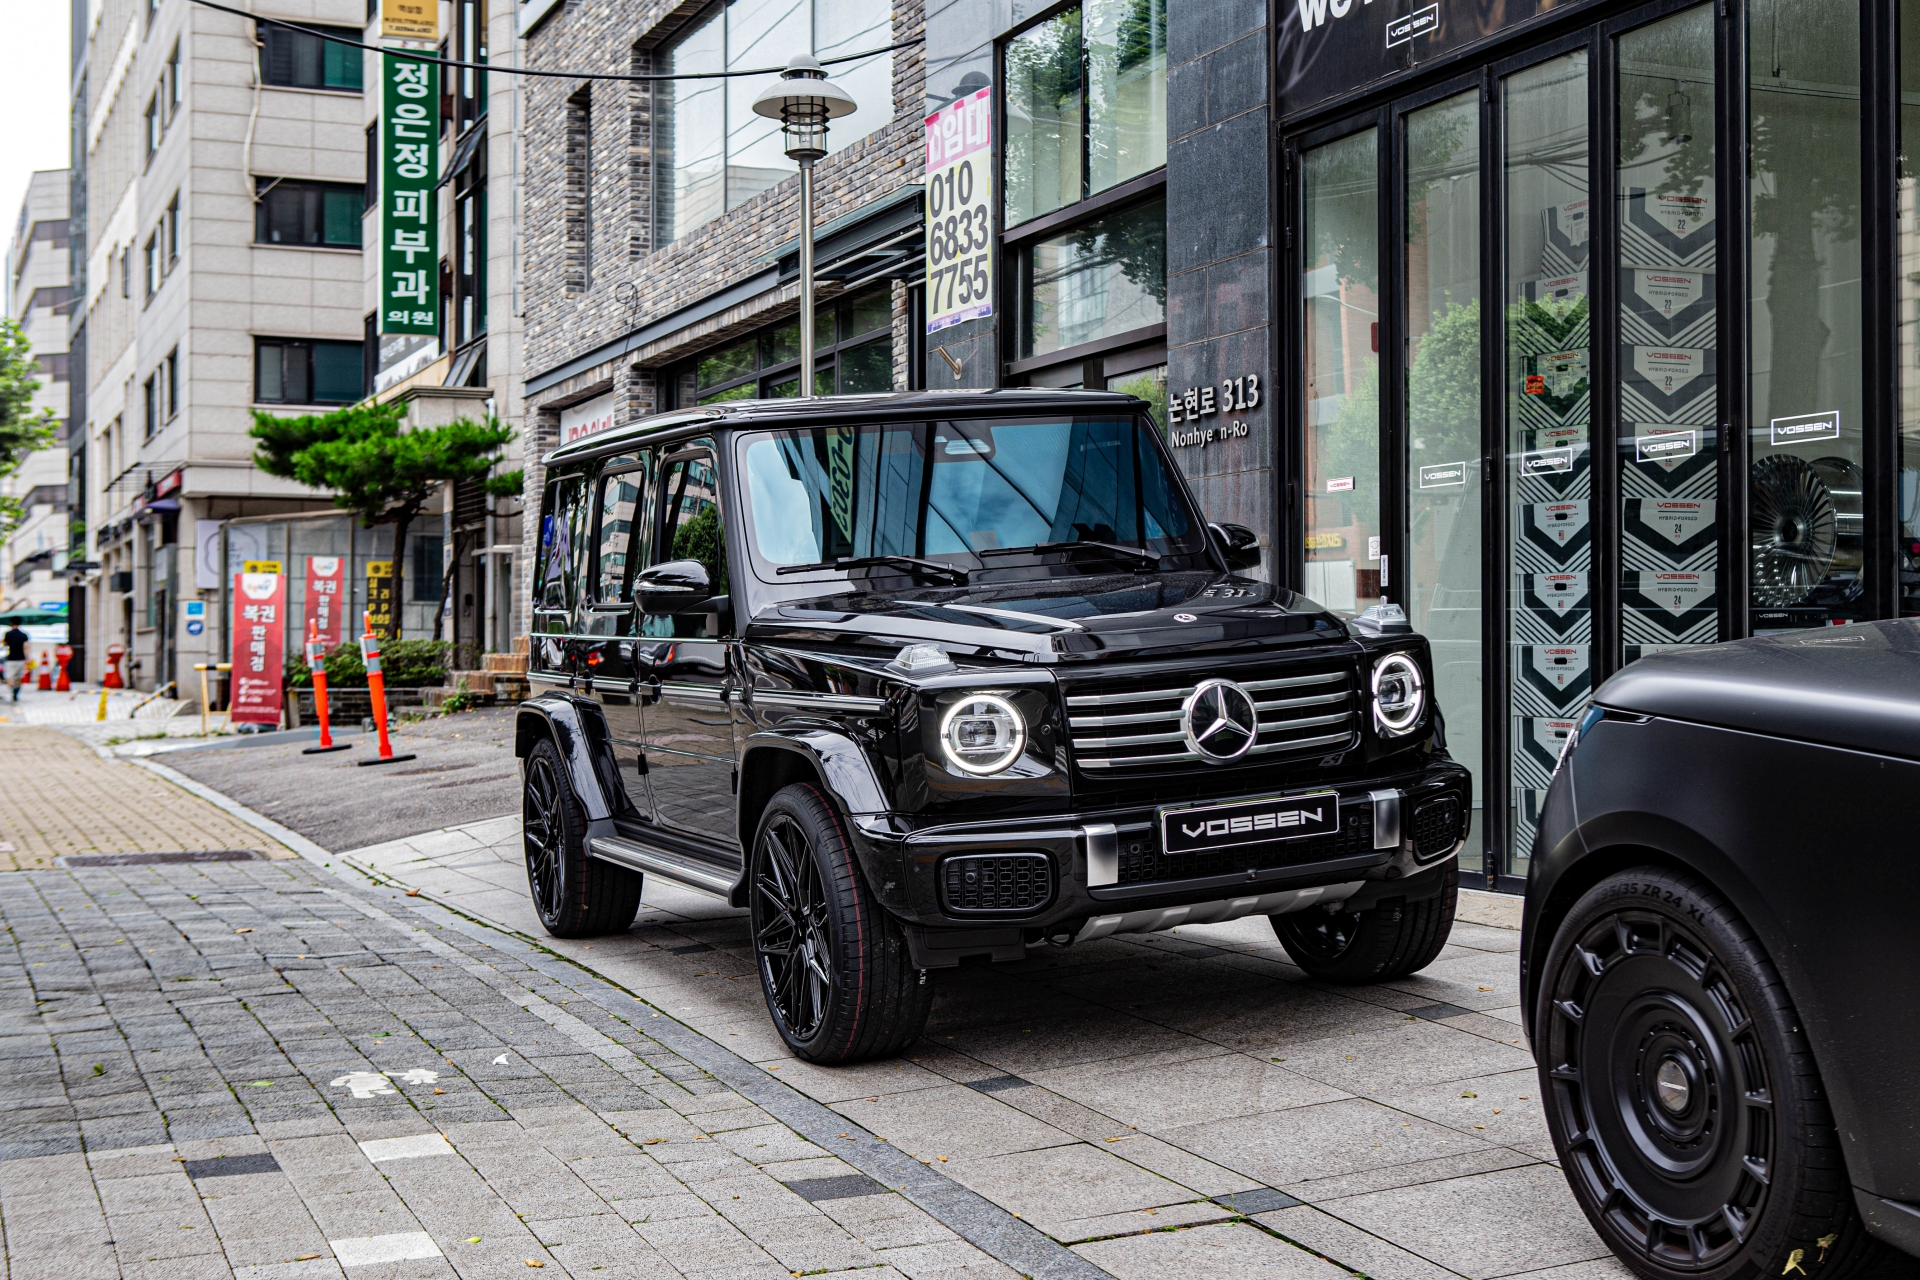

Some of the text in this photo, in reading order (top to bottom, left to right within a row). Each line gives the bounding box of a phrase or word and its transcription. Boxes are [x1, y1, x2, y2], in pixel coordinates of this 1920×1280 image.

[1390, 13, 1434, 37] VOSSEN
[392, 62, 431, 178] 정은정
[929, 160, 974, 218] 010
[1563, 199, 1589, 212] VOSSE
[1658, 195, 1708, 204] VOSSEN
[1677, 219, 1686, 230] 22
[930, 204, 988, 266] 6833
[390, 189, 430, 305] 피부과
[930, 253, 988, 315] 7755
[1544, 276, 1578, 288] VOSSEN
[1647, 275, 1691, 284] VOSSEN
[1664, 299, 1672, 310] 22
[386, 310, 435, 325] 의원
[1646, 352, 1691, 360] VOSSEN
[1664, 375, 1673, 386] 22
[1168, 374, 1259, 423] 논현로 313
[1545, 428, 1579, 438] VOSSEN
[1777, 420, 1833, 434] VOSSEN
[1171, 420, 1248, 448] Nonhyen-Ro
[1642, 440, 1690, 453] VOSSEN
[1526, 456, 1568, 468] VOSSEN
[1424, 470, 1461, 480] VOSSEN
[1545, 504, 1577, 512] VOSSEN
[1674, 523, 1682, 534] 24
[312, 580, 337, 594] 복권
[1673, 595, 1682, 606] 24
[243, 604, 276, 623] 복권
[250, 625, 267, 672] 판매점
[1181, 807, 1323, 838] VOSSEN
[1592, 882, 1706, 927] 95/35 ZR 24 XL
